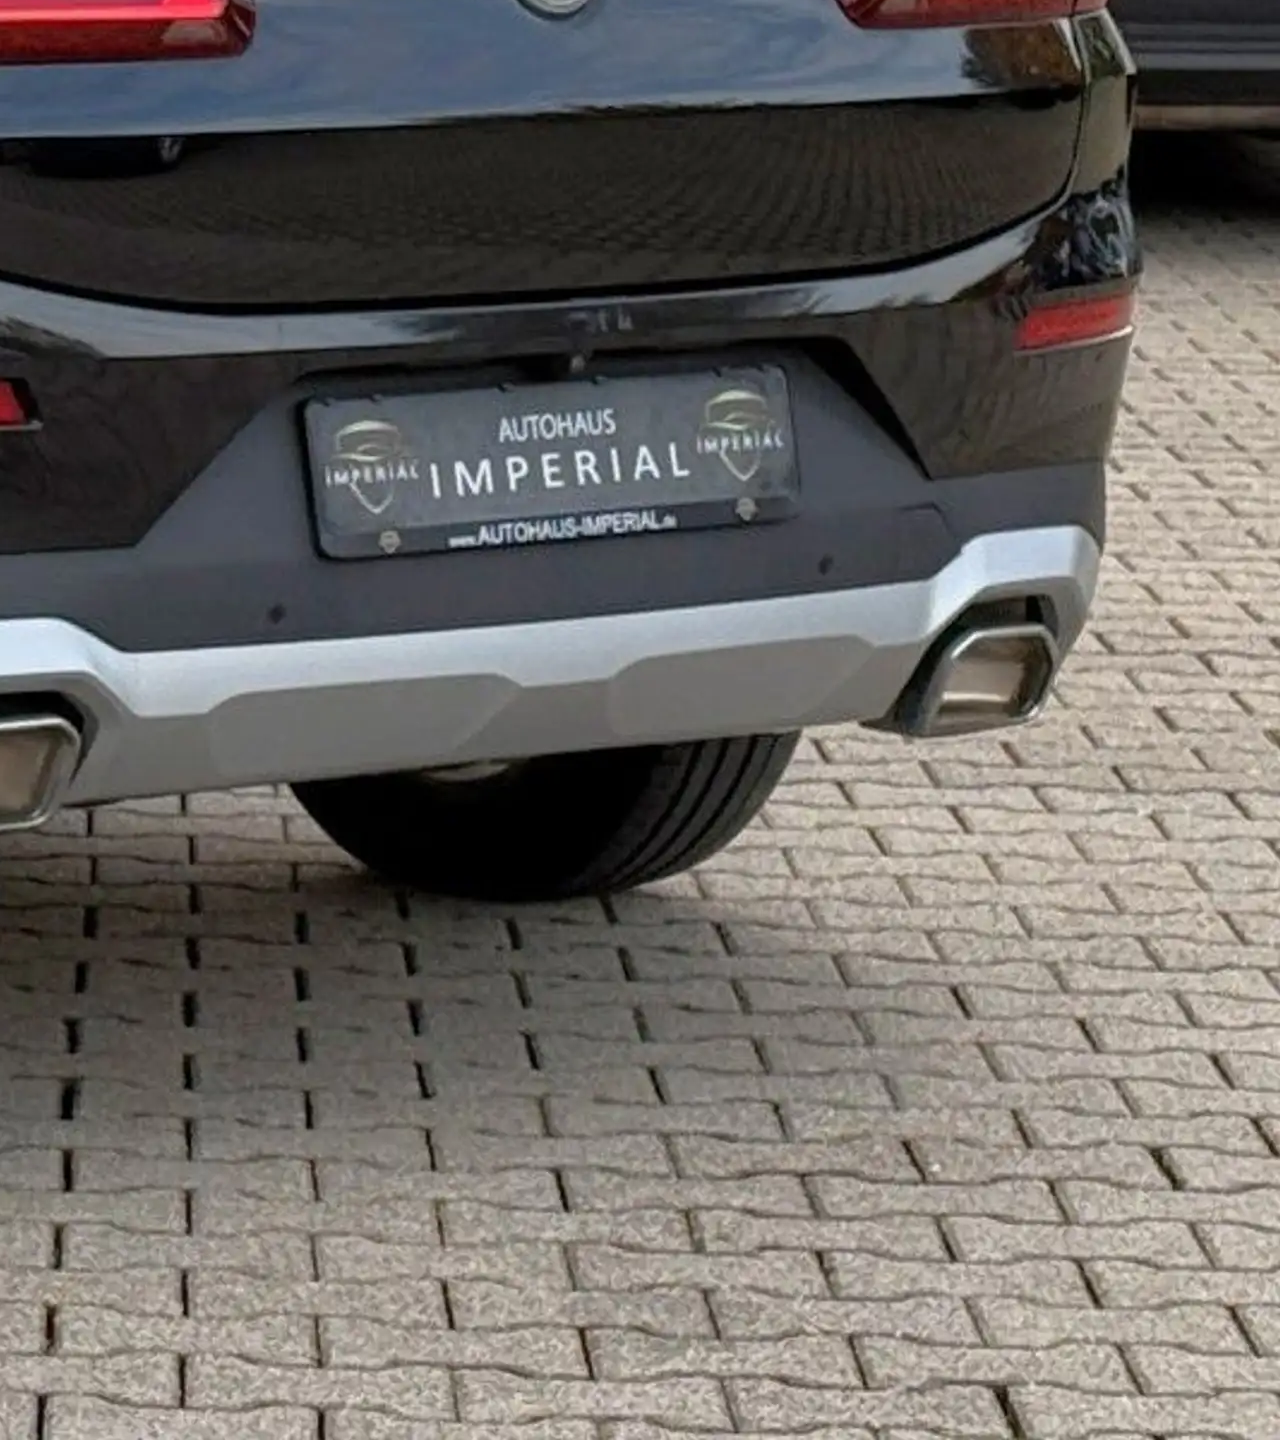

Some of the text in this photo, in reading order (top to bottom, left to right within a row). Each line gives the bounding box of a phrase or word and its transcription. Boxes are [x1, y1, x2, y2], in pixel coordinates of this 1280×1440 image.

[498, 408, 617, 443] AUTOHAUS
[695, 427, 785, 454] IMPERIAL
[325, 459, 420, 487] IMPERIAL
[429, 441, 692, 499] IMPERIAL
